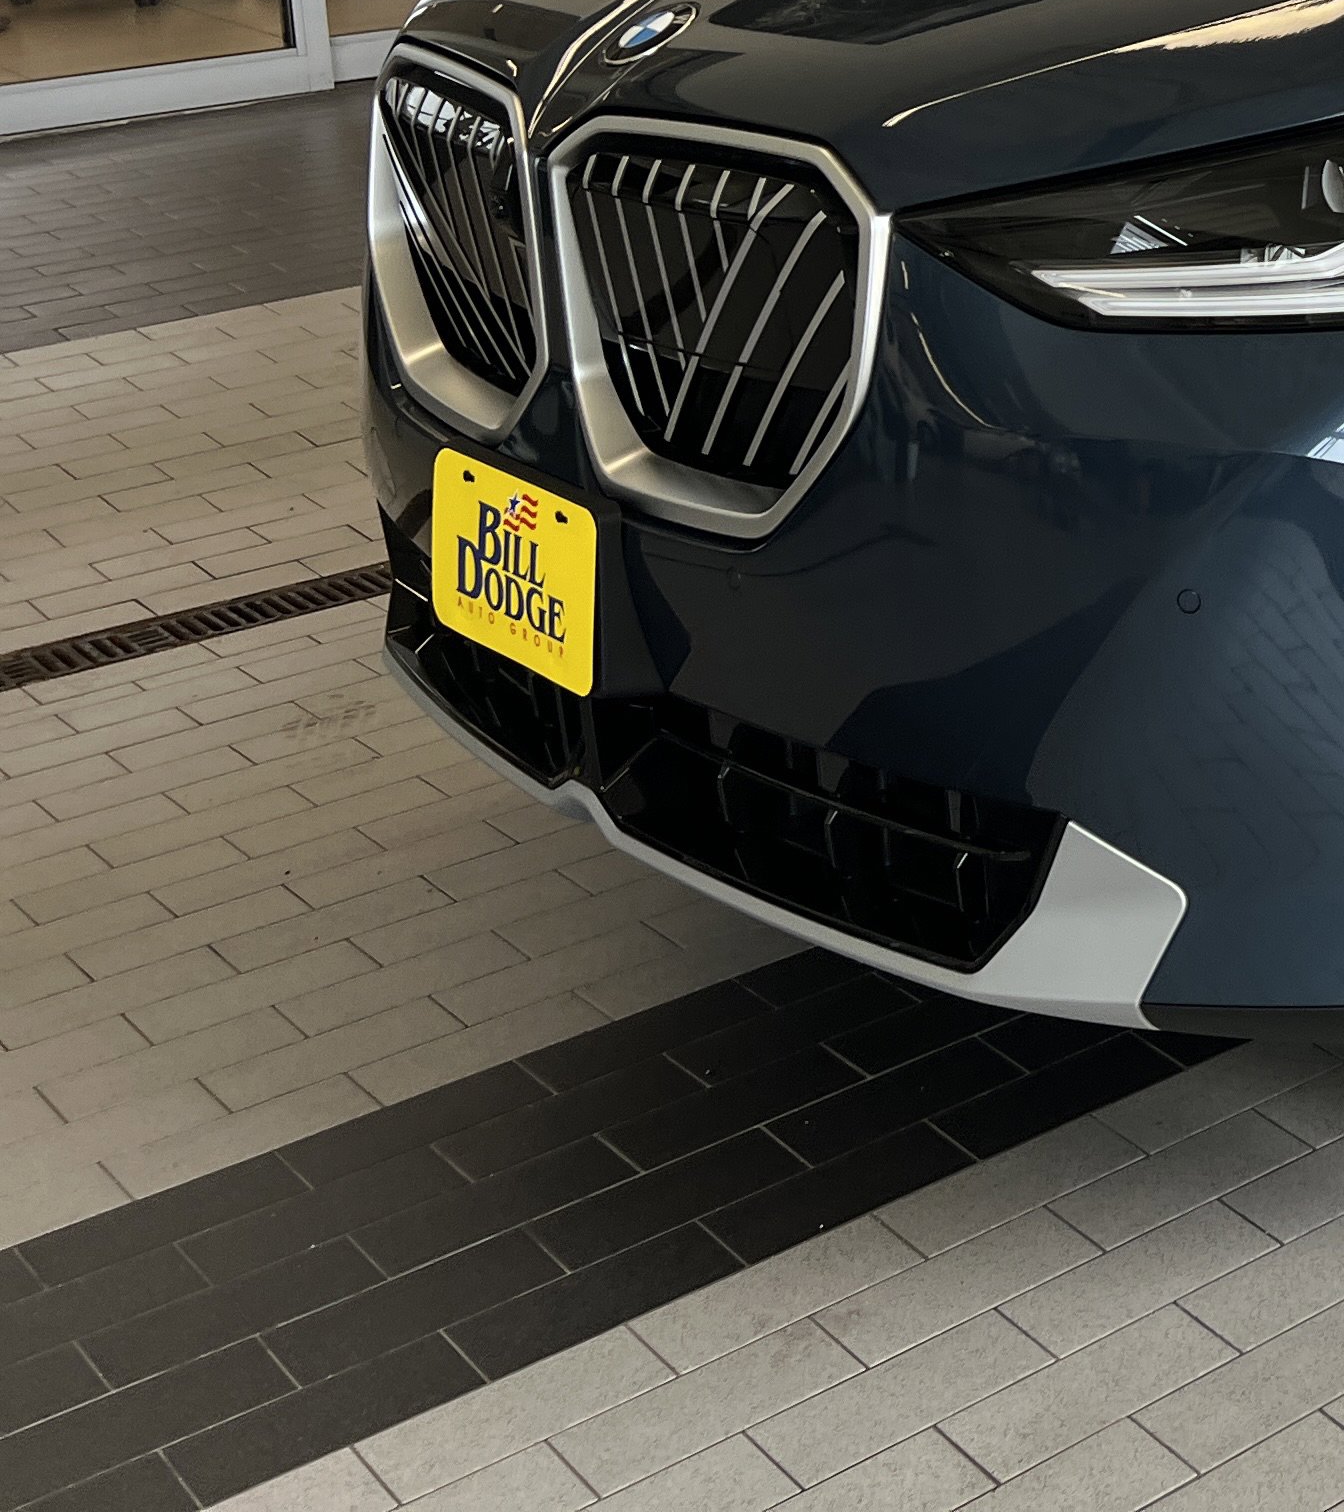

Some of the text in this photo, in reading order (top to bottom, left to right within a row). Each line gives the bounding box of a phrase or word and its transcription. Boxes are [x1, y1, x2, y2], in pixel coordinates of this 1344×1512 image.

[478, 500, 546, 588] BILL
[456, 535, 567, 644] DODGE
[457, 595, 564, 658] AUTO GROUP
